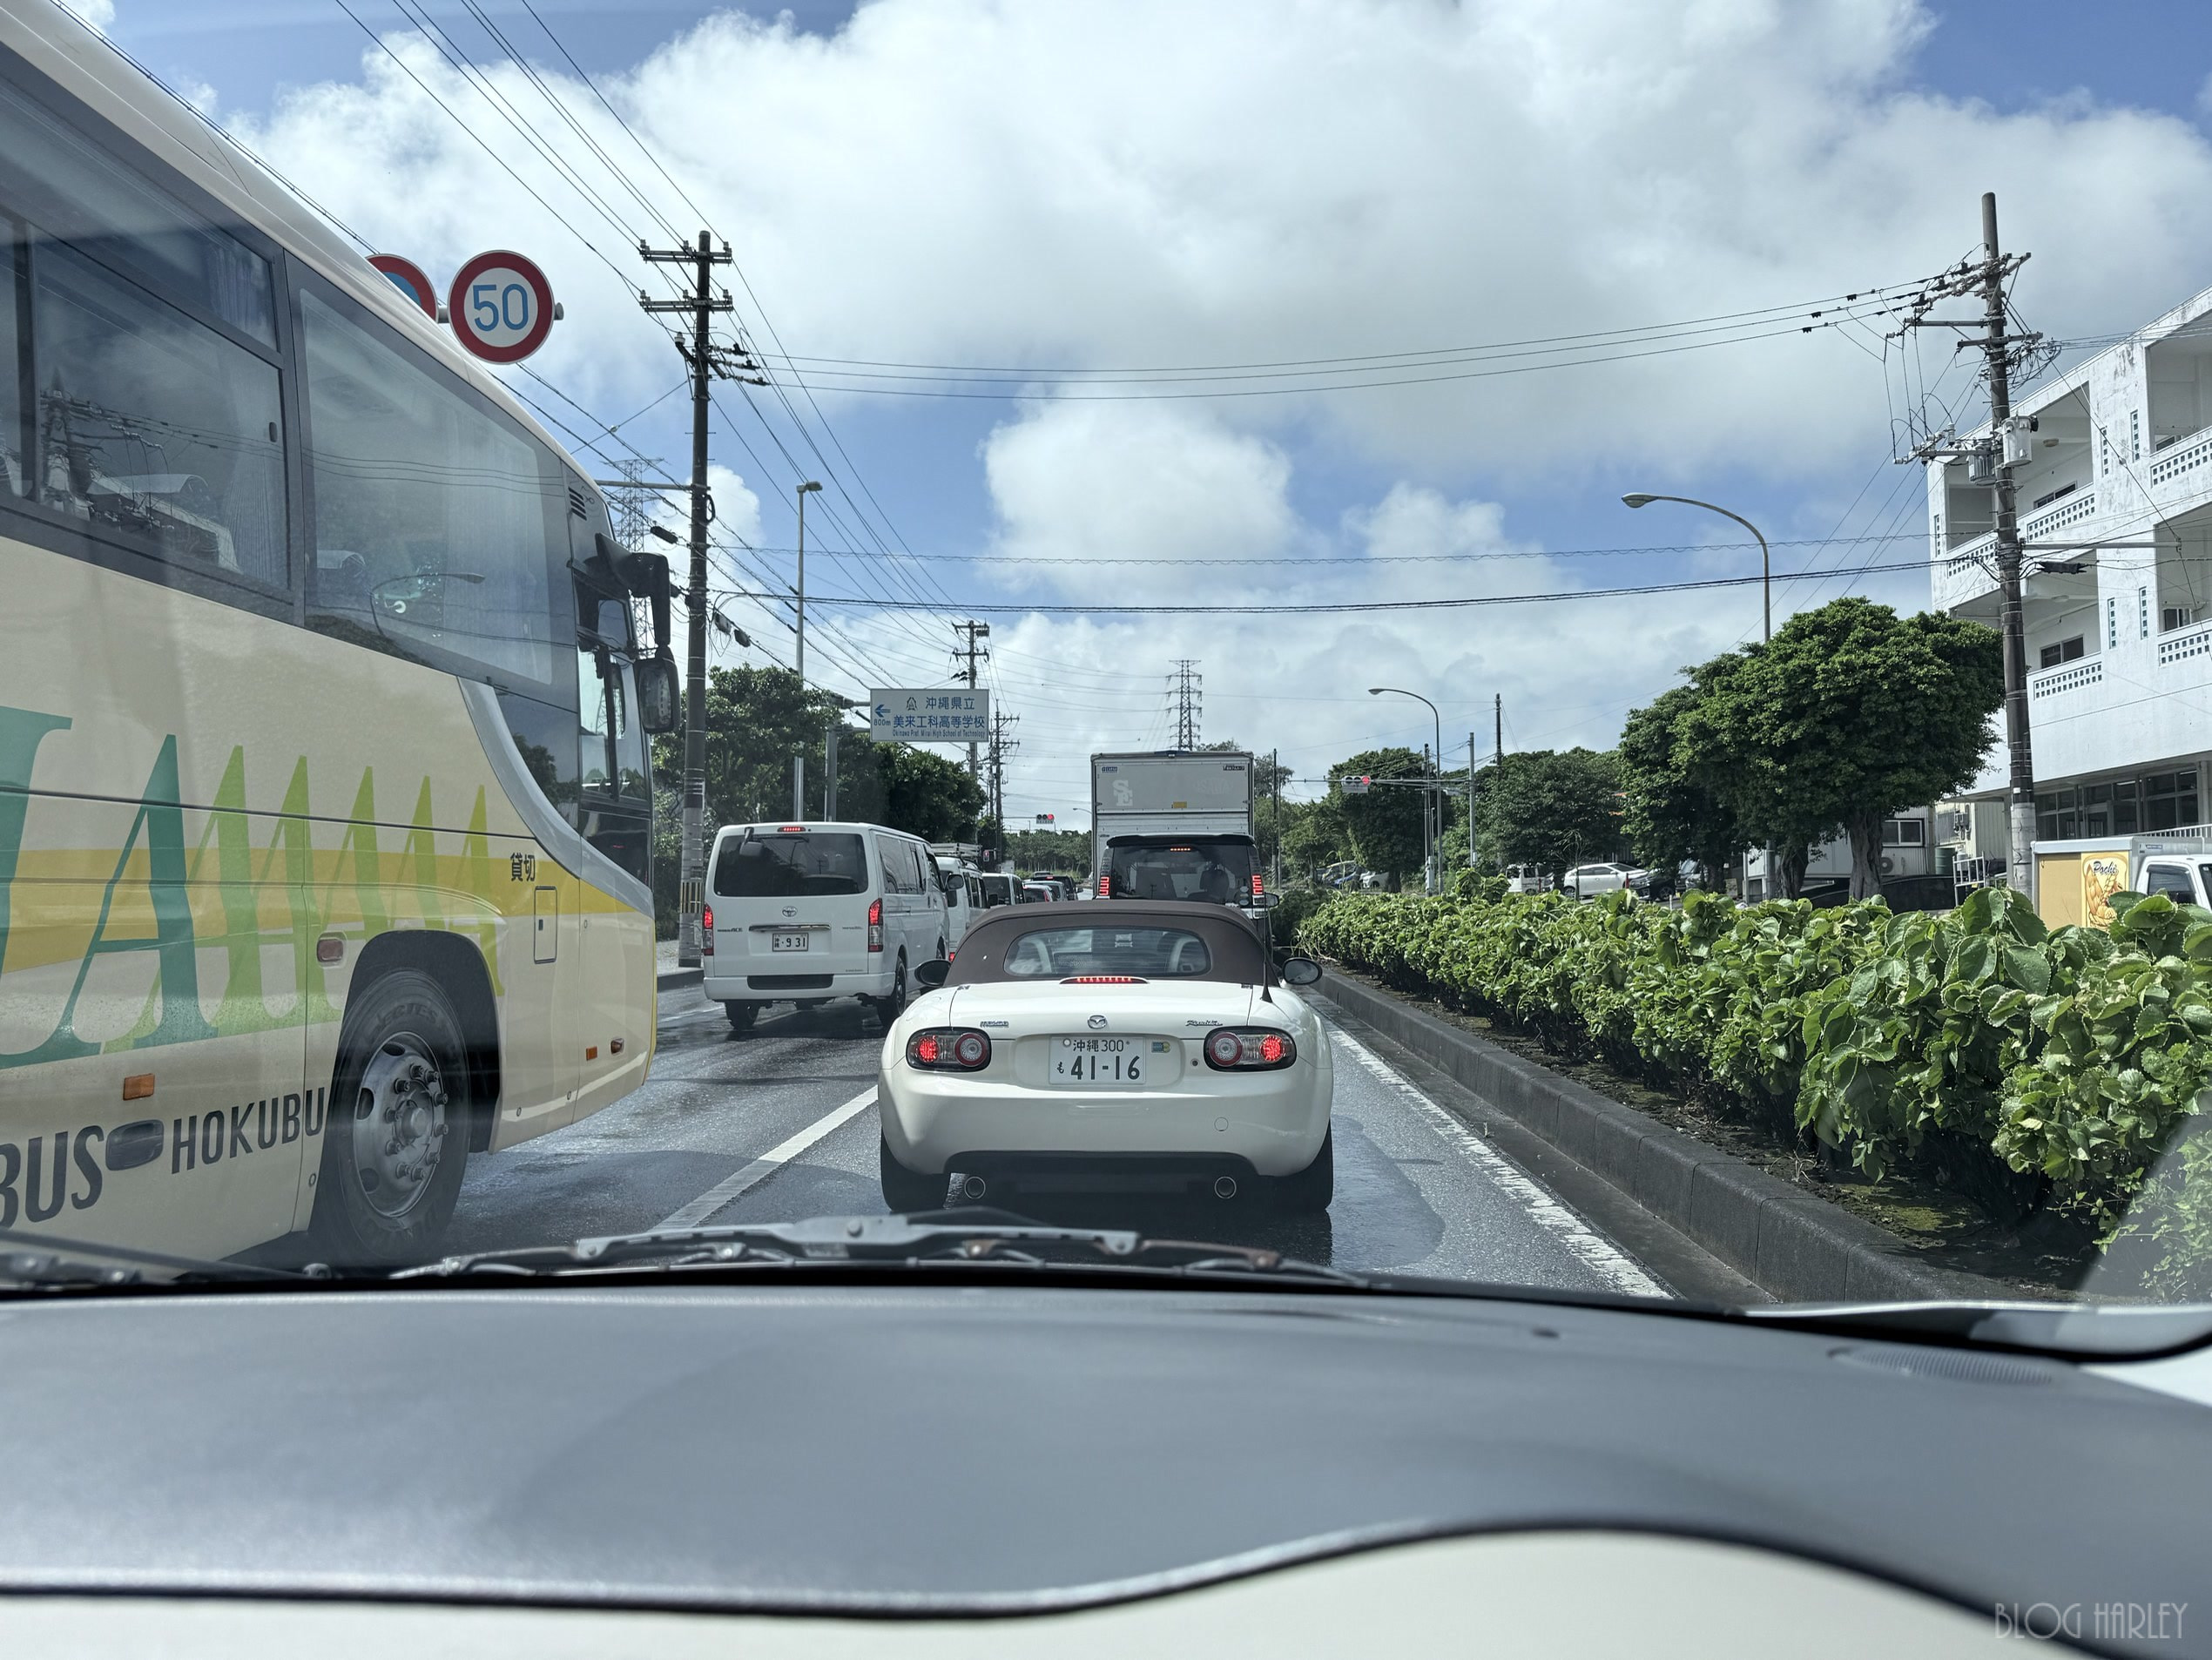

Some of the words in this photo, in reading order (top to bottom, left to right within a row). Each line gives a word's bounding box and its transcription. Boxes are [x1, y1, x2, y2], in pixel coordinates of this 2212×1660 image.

[473, 284, 529, 331] 50
[926, 697, 974, 710] 沖縄県立
[894, 715, 985, 729] 美来工科高等学校
[510, 853, 536, 881] 貸切
[1070, 1056, 1140, 1080] 41-16
[0, 1124, 105, 1230] BUS
[172, 1087, 325, 1175] HOKUBU
